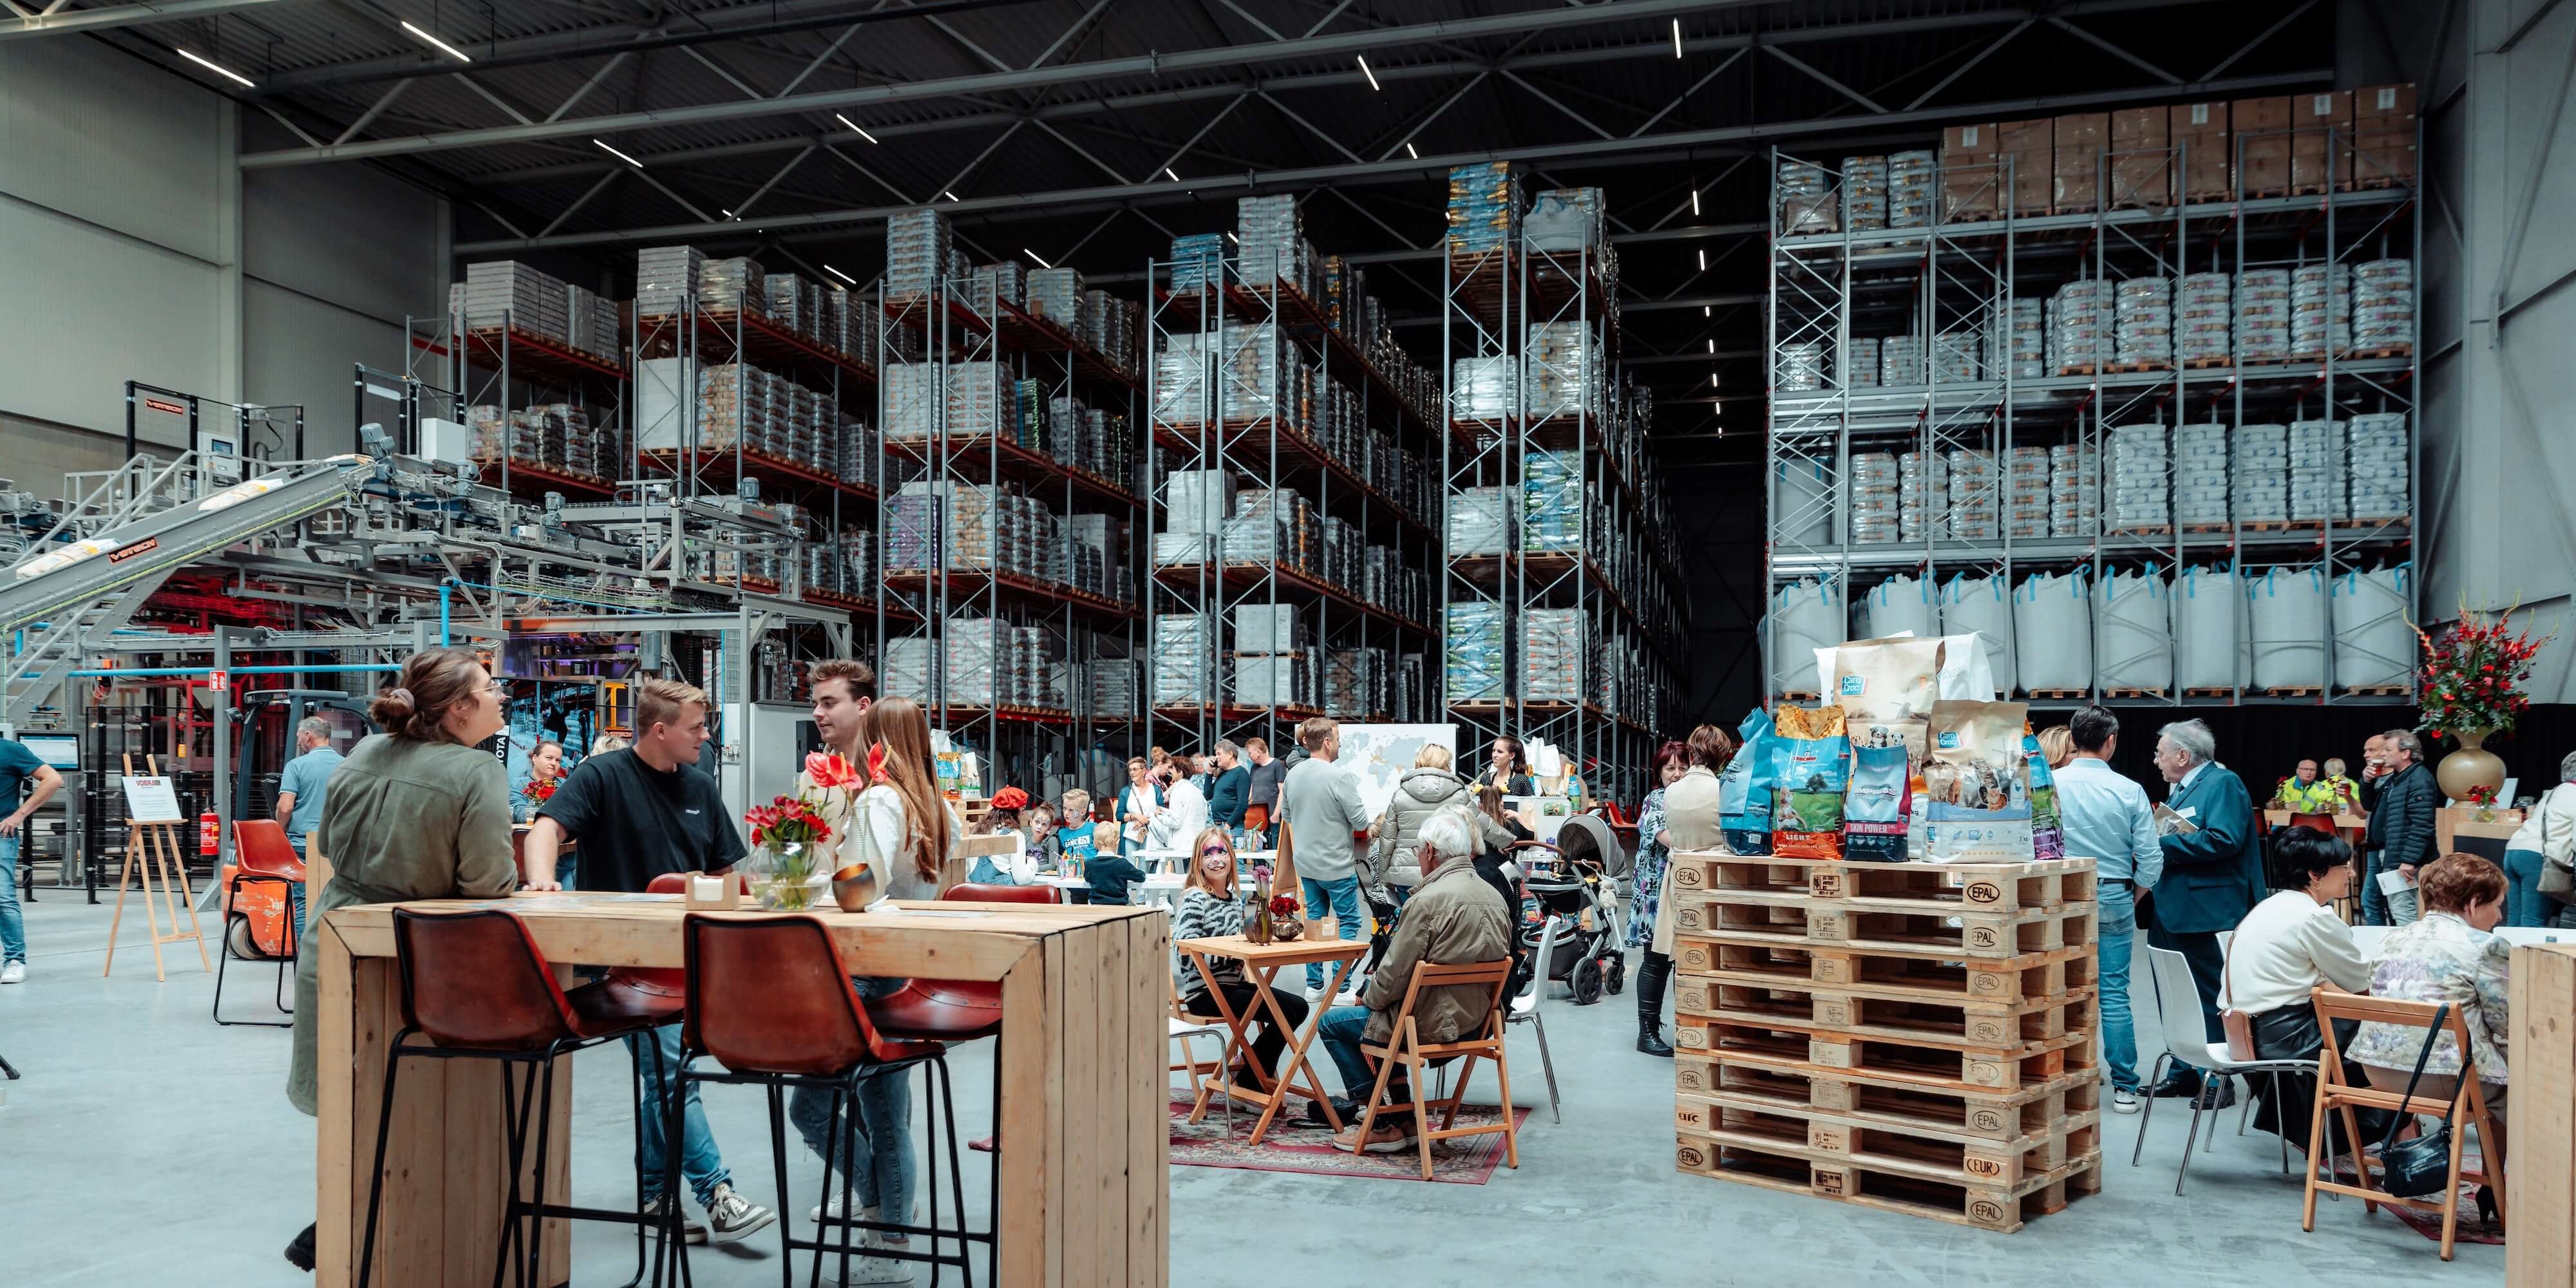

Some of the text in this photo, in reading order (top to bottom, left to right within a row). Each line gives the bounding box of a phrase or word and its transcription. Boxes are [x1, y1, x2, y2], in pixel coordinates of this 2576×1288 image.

[496, 737, 506, 762] OTA
[1850, 823, 1862, 832] SKIN
[1864, 824, 1887, 833] POWER
[1679, 871, 1697, 882] EPAL
[1972, 887, 1996, 899] EPAL
[1972, 931, 1994, 943] EPAL
[1687, 953, 1701, 961] EPAL
[1978, 976, 1995, 987] EPAL
[1686, 995, 1700, 1004] EPAL
[1978, 1026, 1996, 1036] EPAL
[1971, 1066, 1994, 1078] EPL
[1682, 1074, 1700, 1085] EPAL
[1977, 1114, 2000, 1128] EPAL
[1681, 1150, 1700, 1163] EPAL
[1974, 1159, 1994, 1175] EUR
[1975, 1204, 1998, 1219] EPAL
